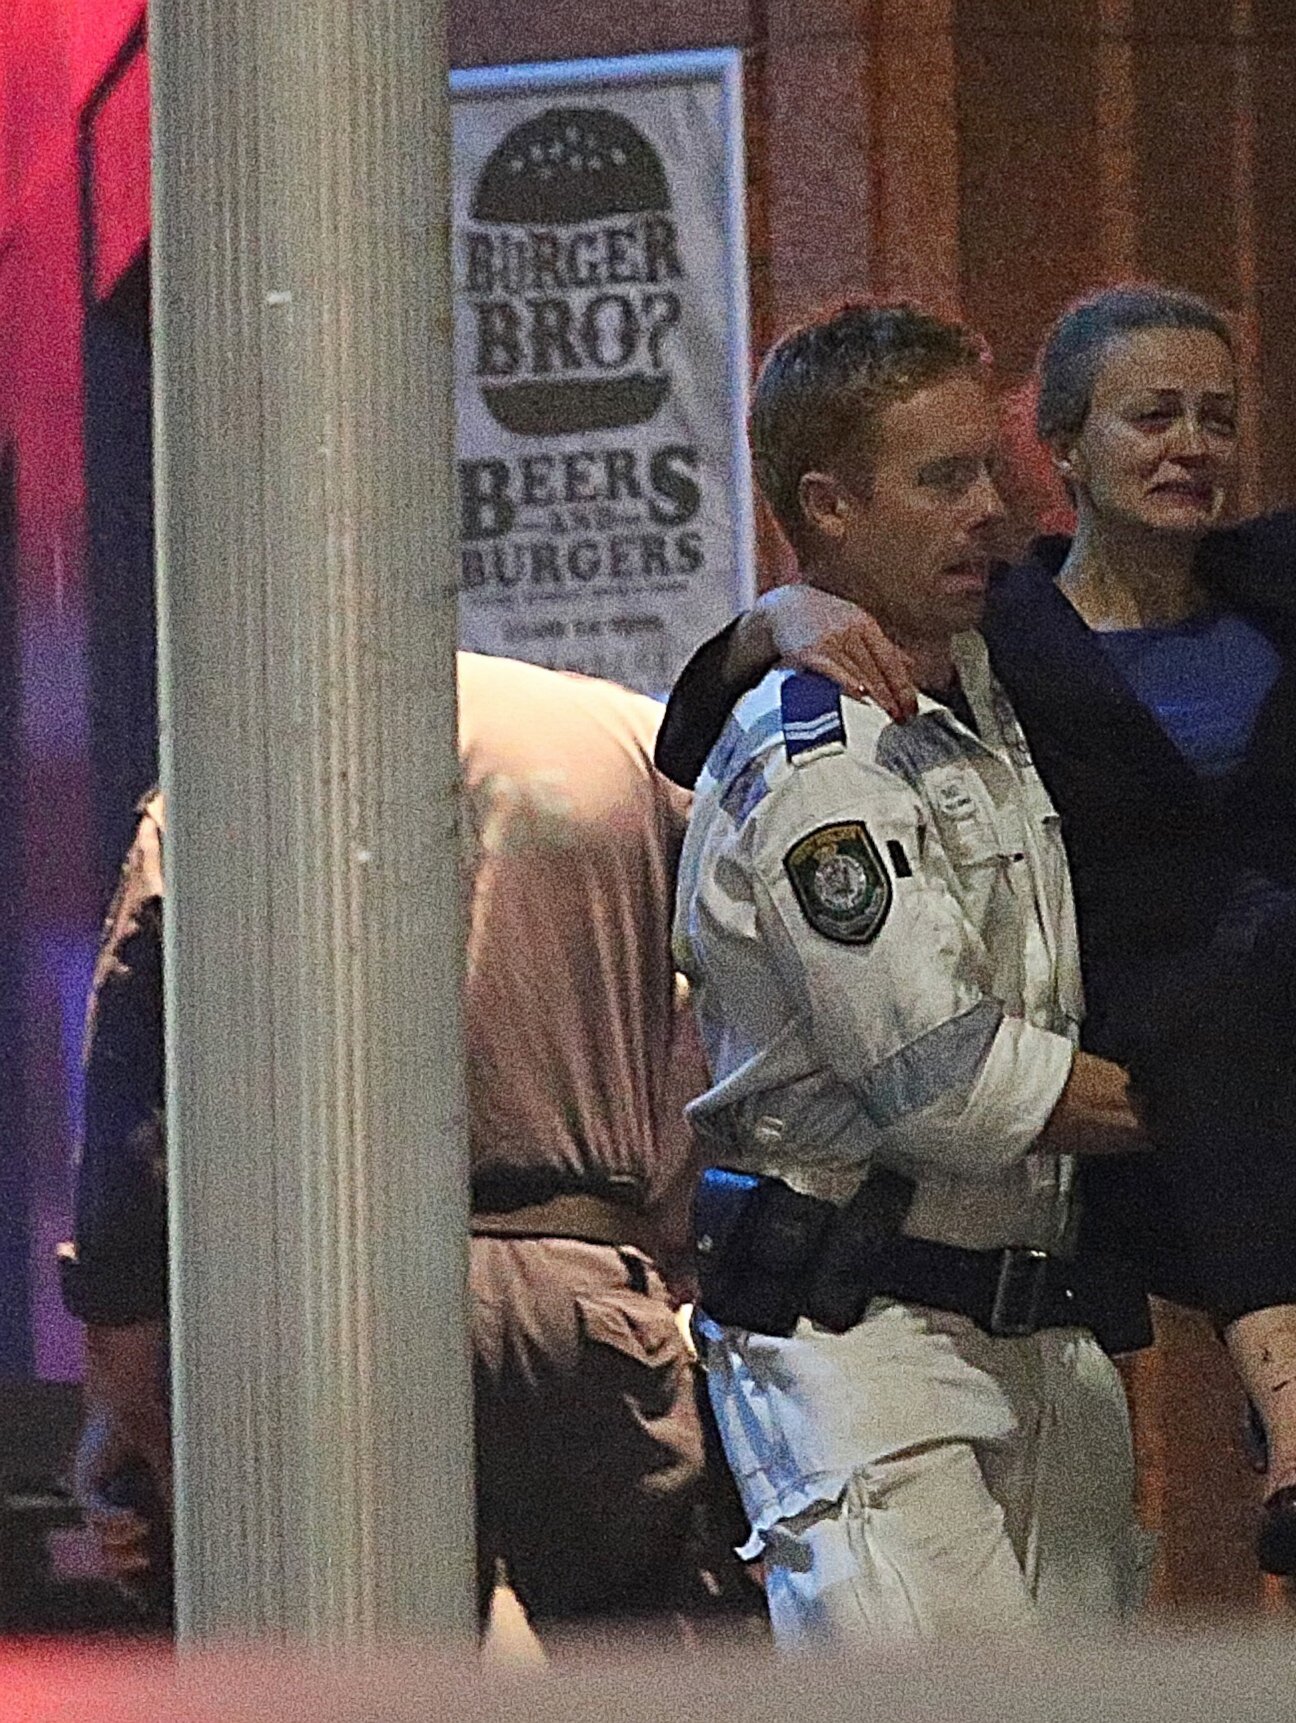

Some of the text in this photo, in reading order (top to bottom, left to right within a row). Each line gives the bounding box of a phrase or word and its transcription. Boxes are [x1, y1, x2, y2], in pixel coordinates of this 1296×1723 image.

[465, 218, 686, 292] BURGER
[473, 293, 681, 376] BRO?
[458, 445, 702, 541] BEERS
[460, 531, 705, 588] BURGERS
